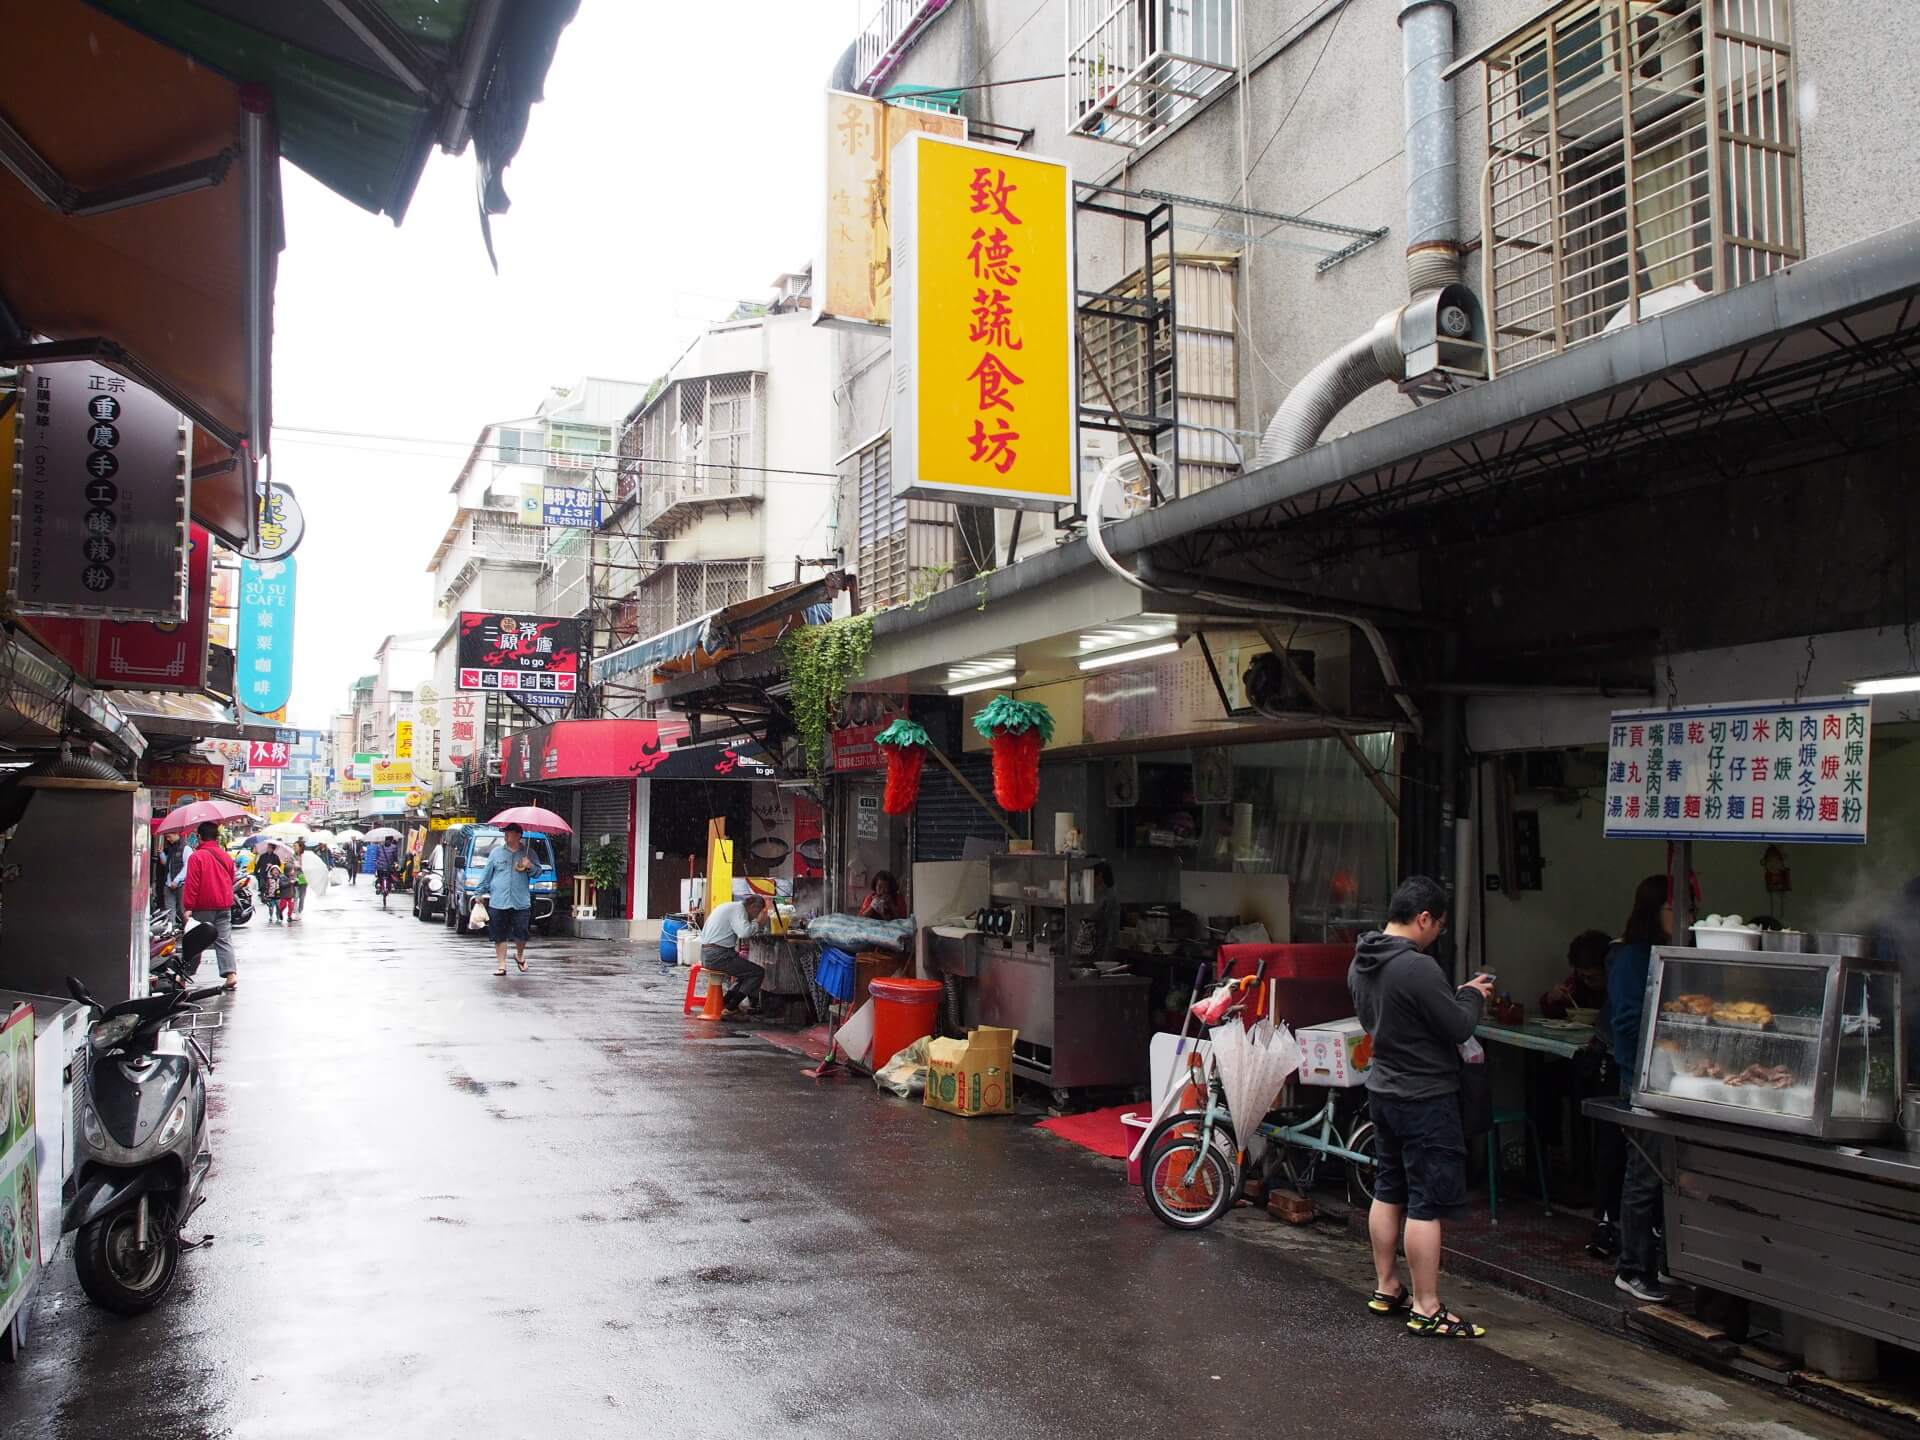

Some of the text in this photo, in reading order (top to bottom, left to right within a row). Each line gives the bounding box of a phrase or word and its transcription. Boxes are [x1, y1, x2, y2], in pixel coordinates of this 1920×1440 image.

[966, 167, 1024, 475] 致德蔬食坊
[88, 375, 126, 393] 正宗
[85, 396, 119, 590] 重慶手工酸辣粉
[246, 583, 286, 595] SU SU
[483, 621, 553, 653] 三顧茅廬
[520, 657, 545, 669] to go
[756, 767, 774, 777] to go
[1625, 725, 1645, 818] 貢丸湯
[1663, 722, 1684, 820] 陽春麵
[1683, 720, 1705, 820] 乾麵
[1705, 721, 1727, 820] 切仔米粉
[1727, 719, 1748, 820] 切仔麵
[1751, 718, 1771, 820] 米苔目
